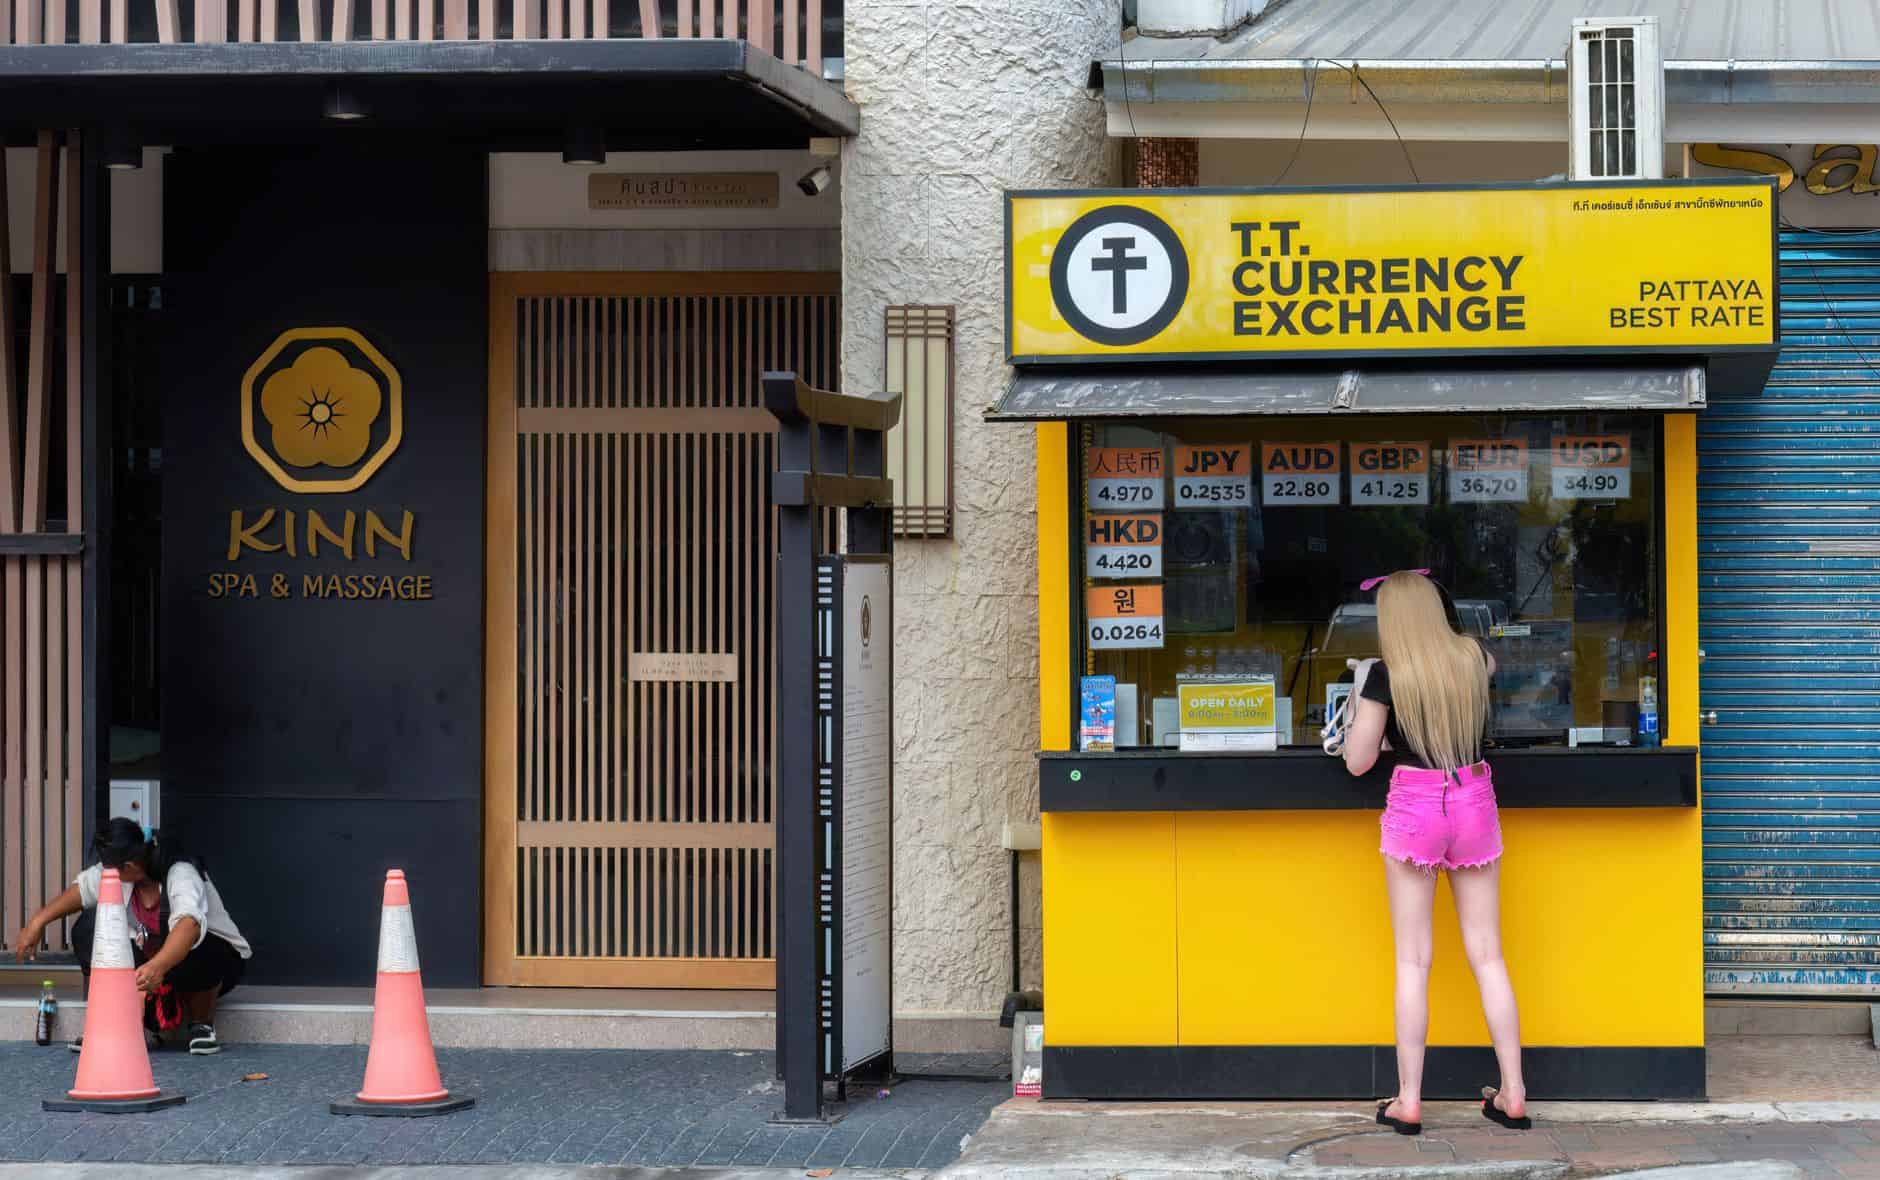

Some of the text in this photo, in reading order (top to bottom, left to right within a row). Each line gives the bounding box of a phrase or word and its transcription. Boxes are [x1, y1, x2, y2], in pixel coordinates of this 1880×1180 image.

[1230, 221, 1310, 257] T.T.
[1232, 255, 1524, 297] CURRENCY
[1639, 279, 1764, 302] PATTAYA
[1233, 295, 1526, 337] EXCHANGE
[1610, 306, 1765, 328] BEST RATE
[1090, 450, 1161, 474] 人民币
[1184, 450, 1241, 473] JPY
[1268, 446, 1336, 472] AUD
[1358, 446, 1421, 472] GBP
[1457, 443, 1520, 467] EUR
[1559, 440, 1624, 465] USD
[1098, 485, 1154, 502] 4.970
[1180, 483, 1246, 502] 0.2535
[1272, 480, 1330, 498] 22.80
[1360, 480, 1419, 499] 41.25
[1461, 477, 1518, 495] 36.70
[227, 508, 415, 561] KINN
[1090, 519, 1159, 544] HKD
[1096, 554, 1153, 571] 4.420
[207, 573, 433, 600] SPA & MASSAGE
[1113, 588, 1136, 615] 원
[1090, 625, 1162, 642] 0.0264
[1190, 696, 1265, 709] OPEN DAILY
